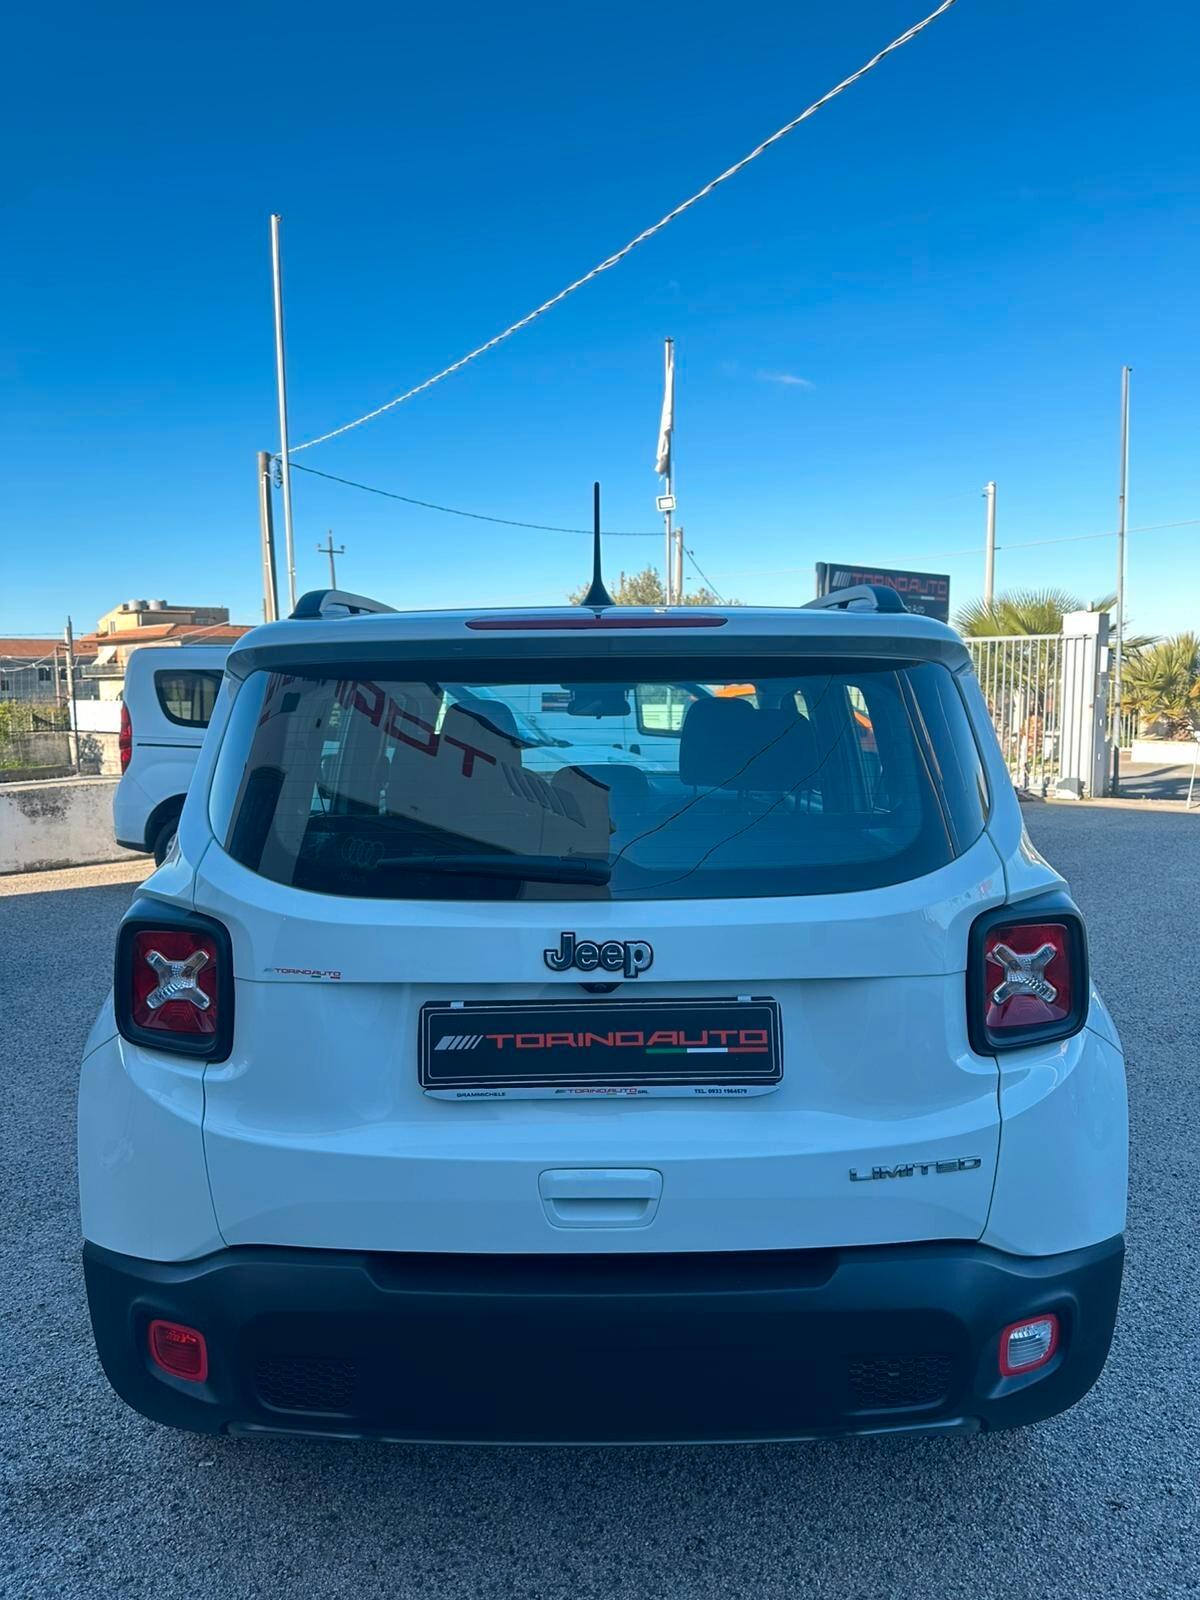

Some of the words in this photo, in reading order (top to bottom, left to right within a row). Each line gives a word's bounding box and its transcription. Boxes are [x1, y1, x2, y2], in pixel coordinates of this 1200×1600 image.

[543, 931, 654, 979] Jeep
[274, 967, 342, 977] TORINOAUTO
[486, 1029, 768, 1049] TORINOAUTO
[567, 1087, 637, 1095] TORINOAUTO
[849, 1155, 982, 1182] LIMITED
